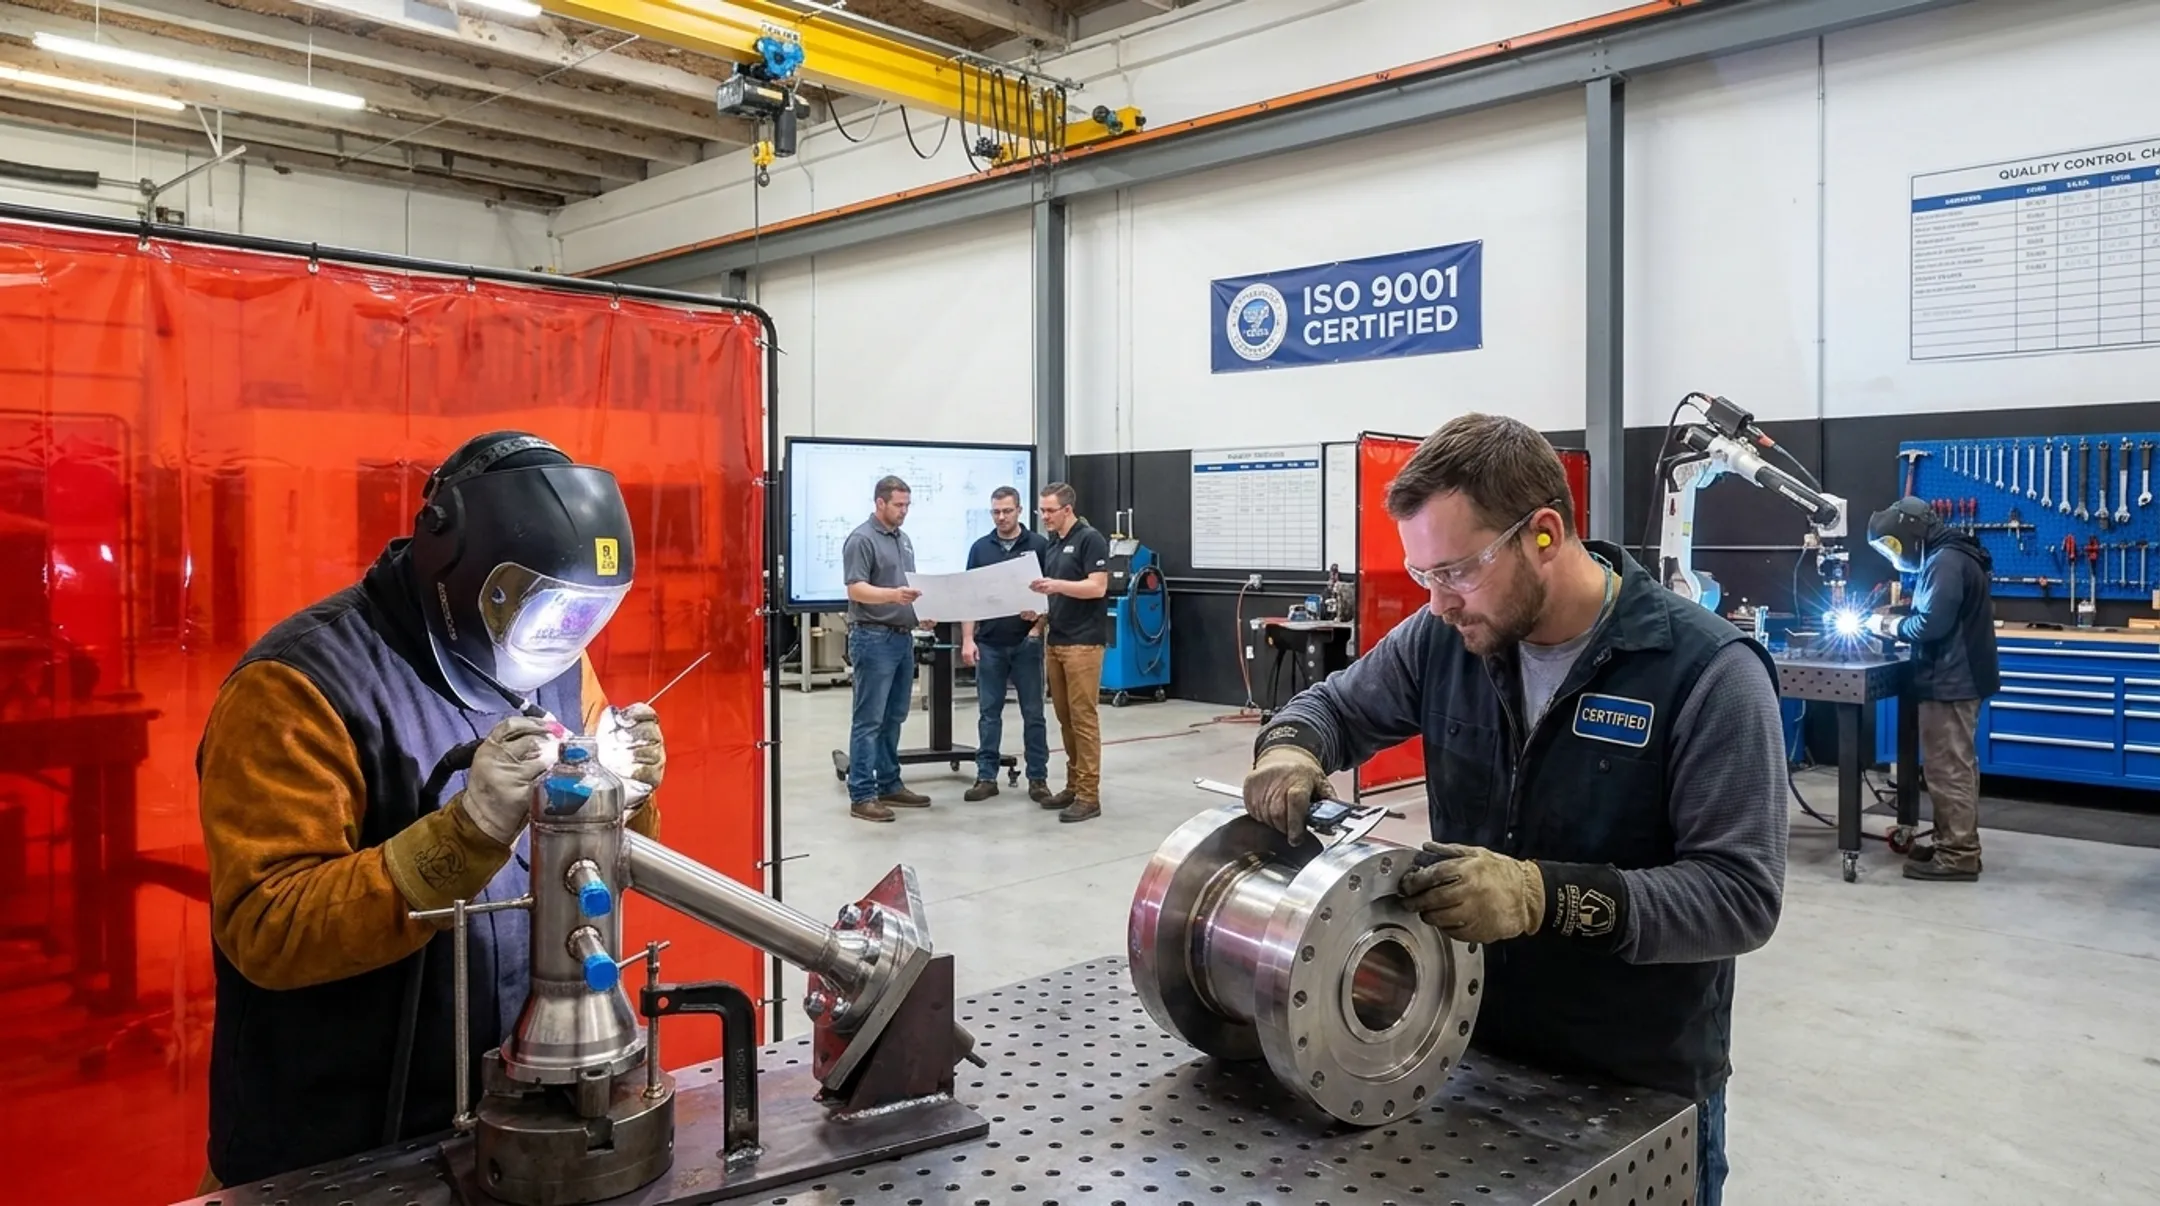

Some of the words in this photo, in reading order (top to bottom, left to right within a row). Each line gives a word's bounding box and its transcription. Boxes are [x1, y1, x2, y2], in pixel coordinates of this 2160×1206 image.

[1999, 161, 2060, 180] QUALITY
[2064, 151, 2136, 171] CONTROL
[1303, 280, 1361, 316] ISO
[1371, 265, 1459, 308] 9001
[1303, 304, 1459, 346] CERTIFIED
[1581, 707, 1647, 730] CERTIFIED
